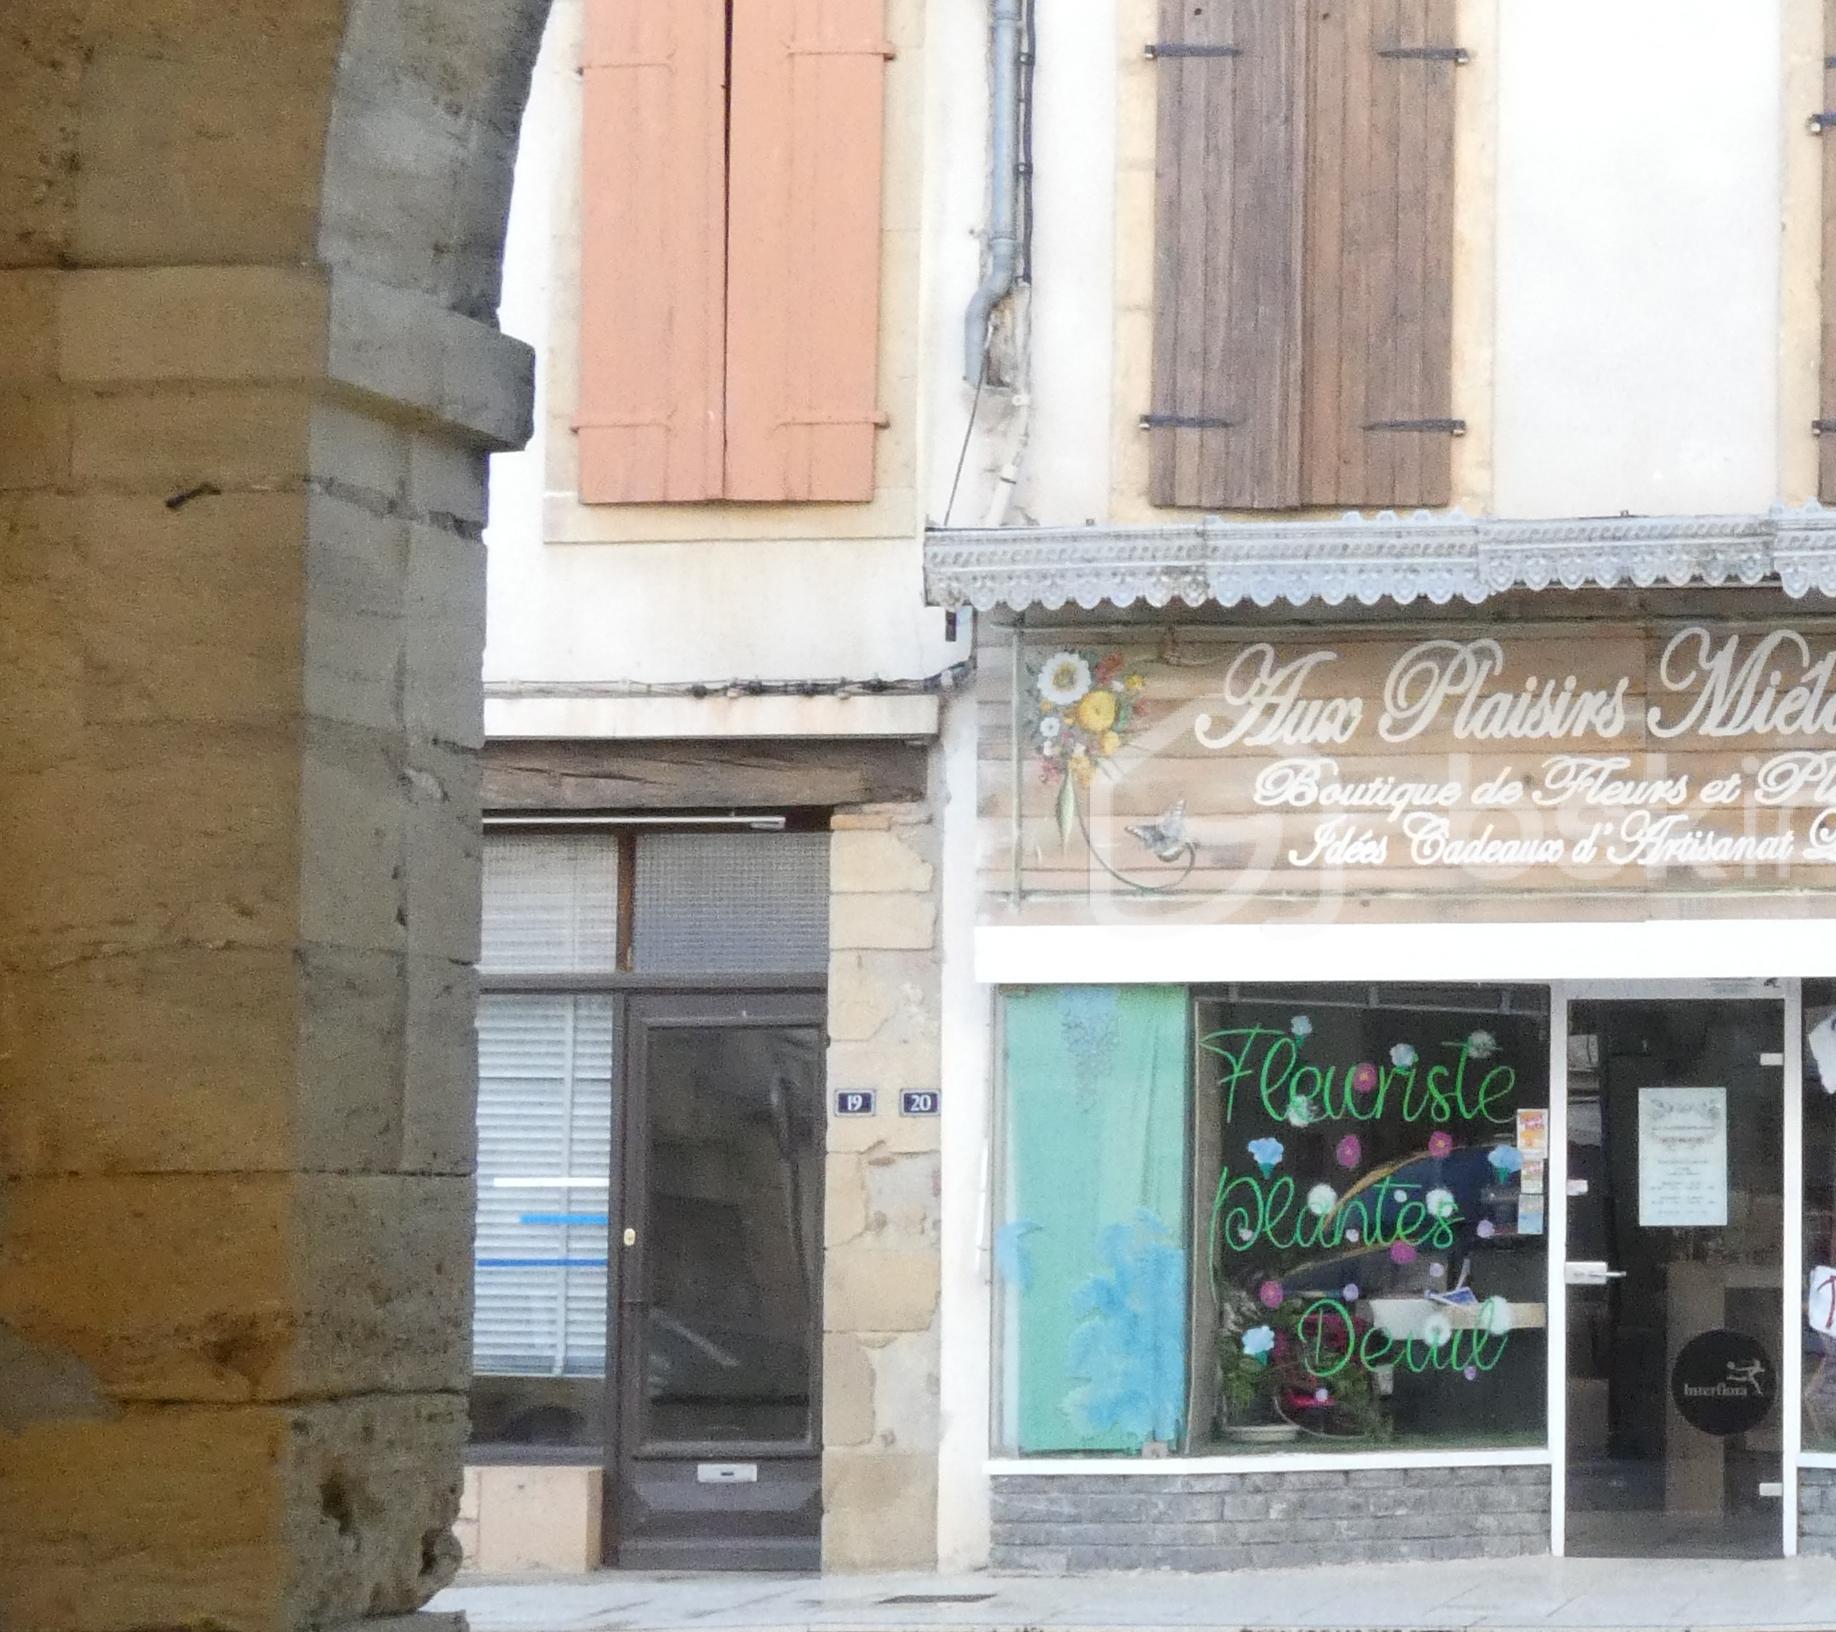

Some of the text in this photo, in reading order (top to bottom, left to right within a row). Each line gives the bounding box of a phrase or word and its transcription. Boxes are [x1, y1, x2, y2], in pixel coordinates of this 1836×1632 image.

[1194, 642, 1363, 749] Aux
[1378, 638, 1630, 743] Plaisirs
[1253, 757, 1462, 822] Boutique
[1470, 767, 1523, 805] de
[1532, 755, 1688, 806] Fleurs
[1700, 773, 1742, 804] et
[1288, 814, 1388, 866] Idées
[1402, 811, 1565, 866] Cadeaux
[847, 1094, 863, 1111] 19
[910, 1094, 932, 1112] 20
[1199, 1023, 1516, 1124] Fleuriste
[1296, 1296, 1509, 1378] Deuil
